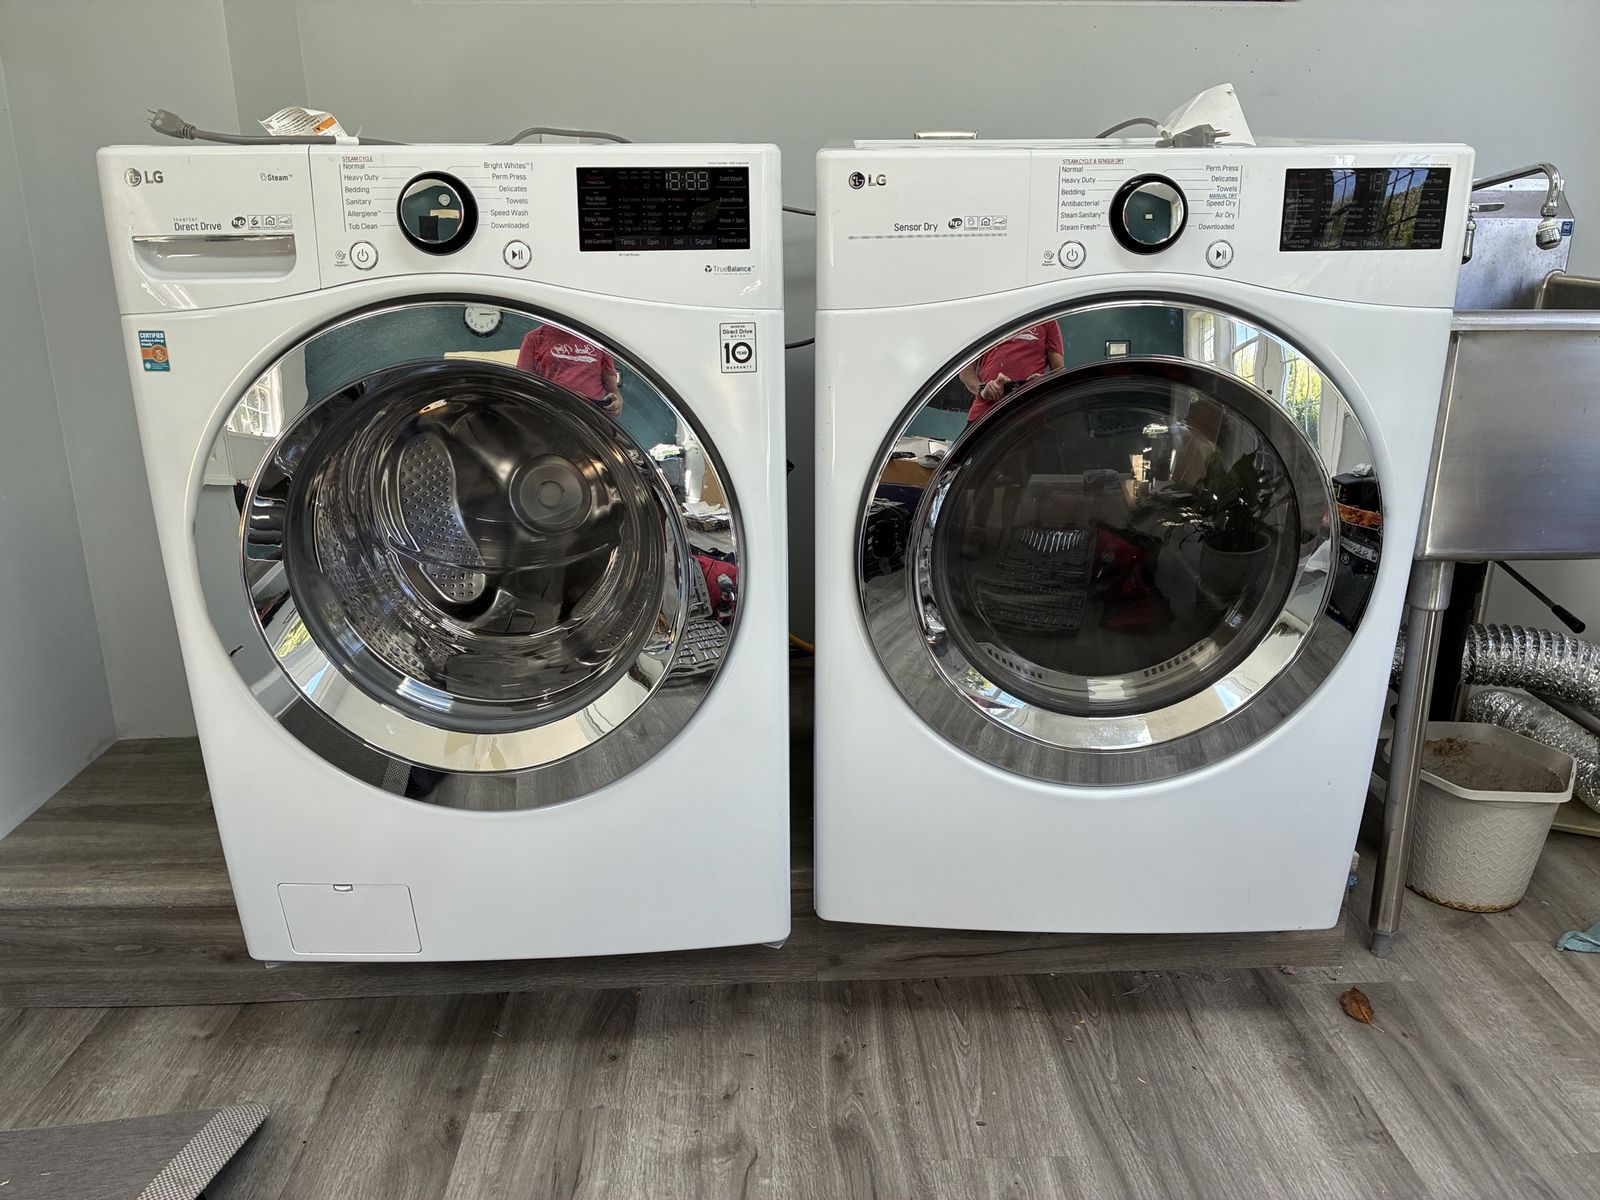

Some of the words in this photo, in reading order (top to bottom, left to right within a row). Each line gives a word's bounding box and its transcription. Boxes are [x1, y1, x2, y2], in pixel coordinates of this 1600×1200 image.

[484, 162, 503, 170] Bright
[145, 170, 164, 184] LG
[364, 174, 379, 182] Duty
[868, 174, 887, 187] LG
[345, 186, 370, 194] Bedding
[490, 209, 510, 217] Speed
[174, 223, 199, 231] Direct
[201, 222, 222, 230] Drive
[894, 223, 922, 232] Sensor
[924, 222, 938, 232] Dry
[724, 342, 753, 364] 10
